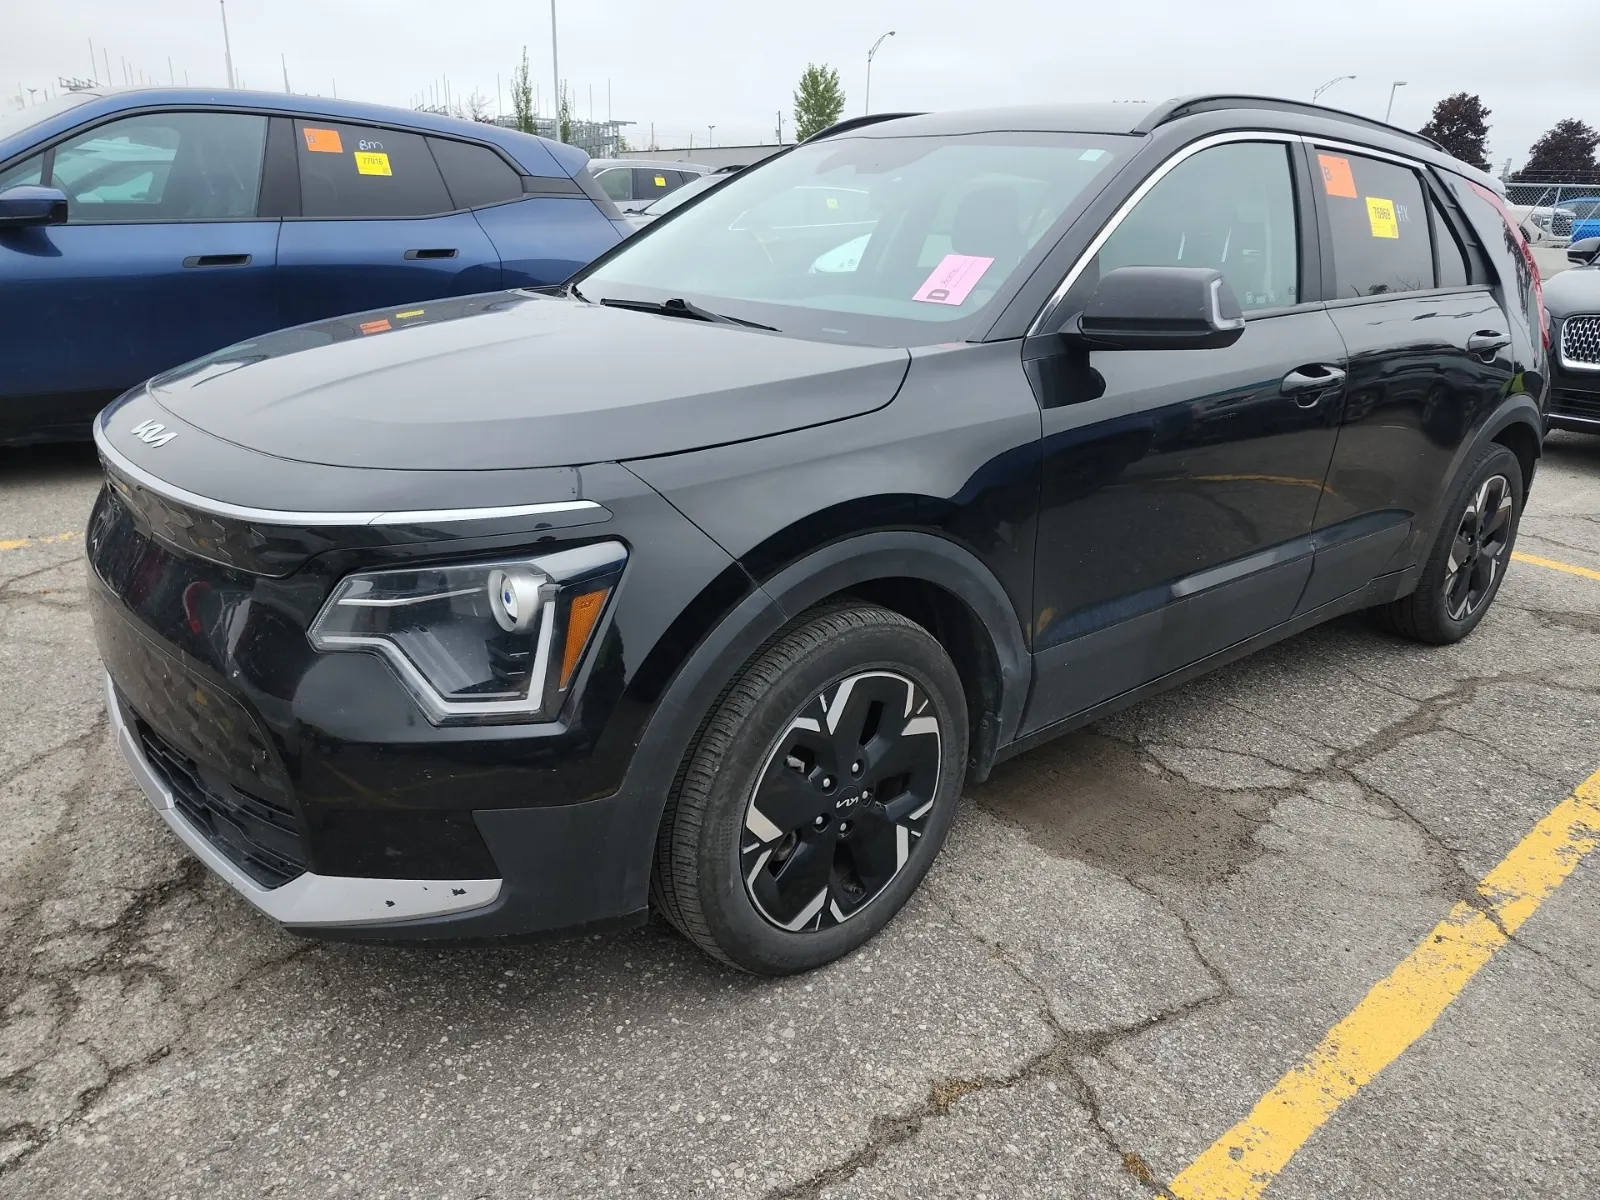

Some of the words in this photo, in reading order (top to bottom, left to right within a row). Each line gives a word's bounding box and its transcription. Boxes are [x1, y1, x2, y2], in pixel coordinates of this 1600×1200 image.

[1322, 165, 1333, 181] B
[926, 288, 950, 301] D
[130, 419, 178, 448] KIA
